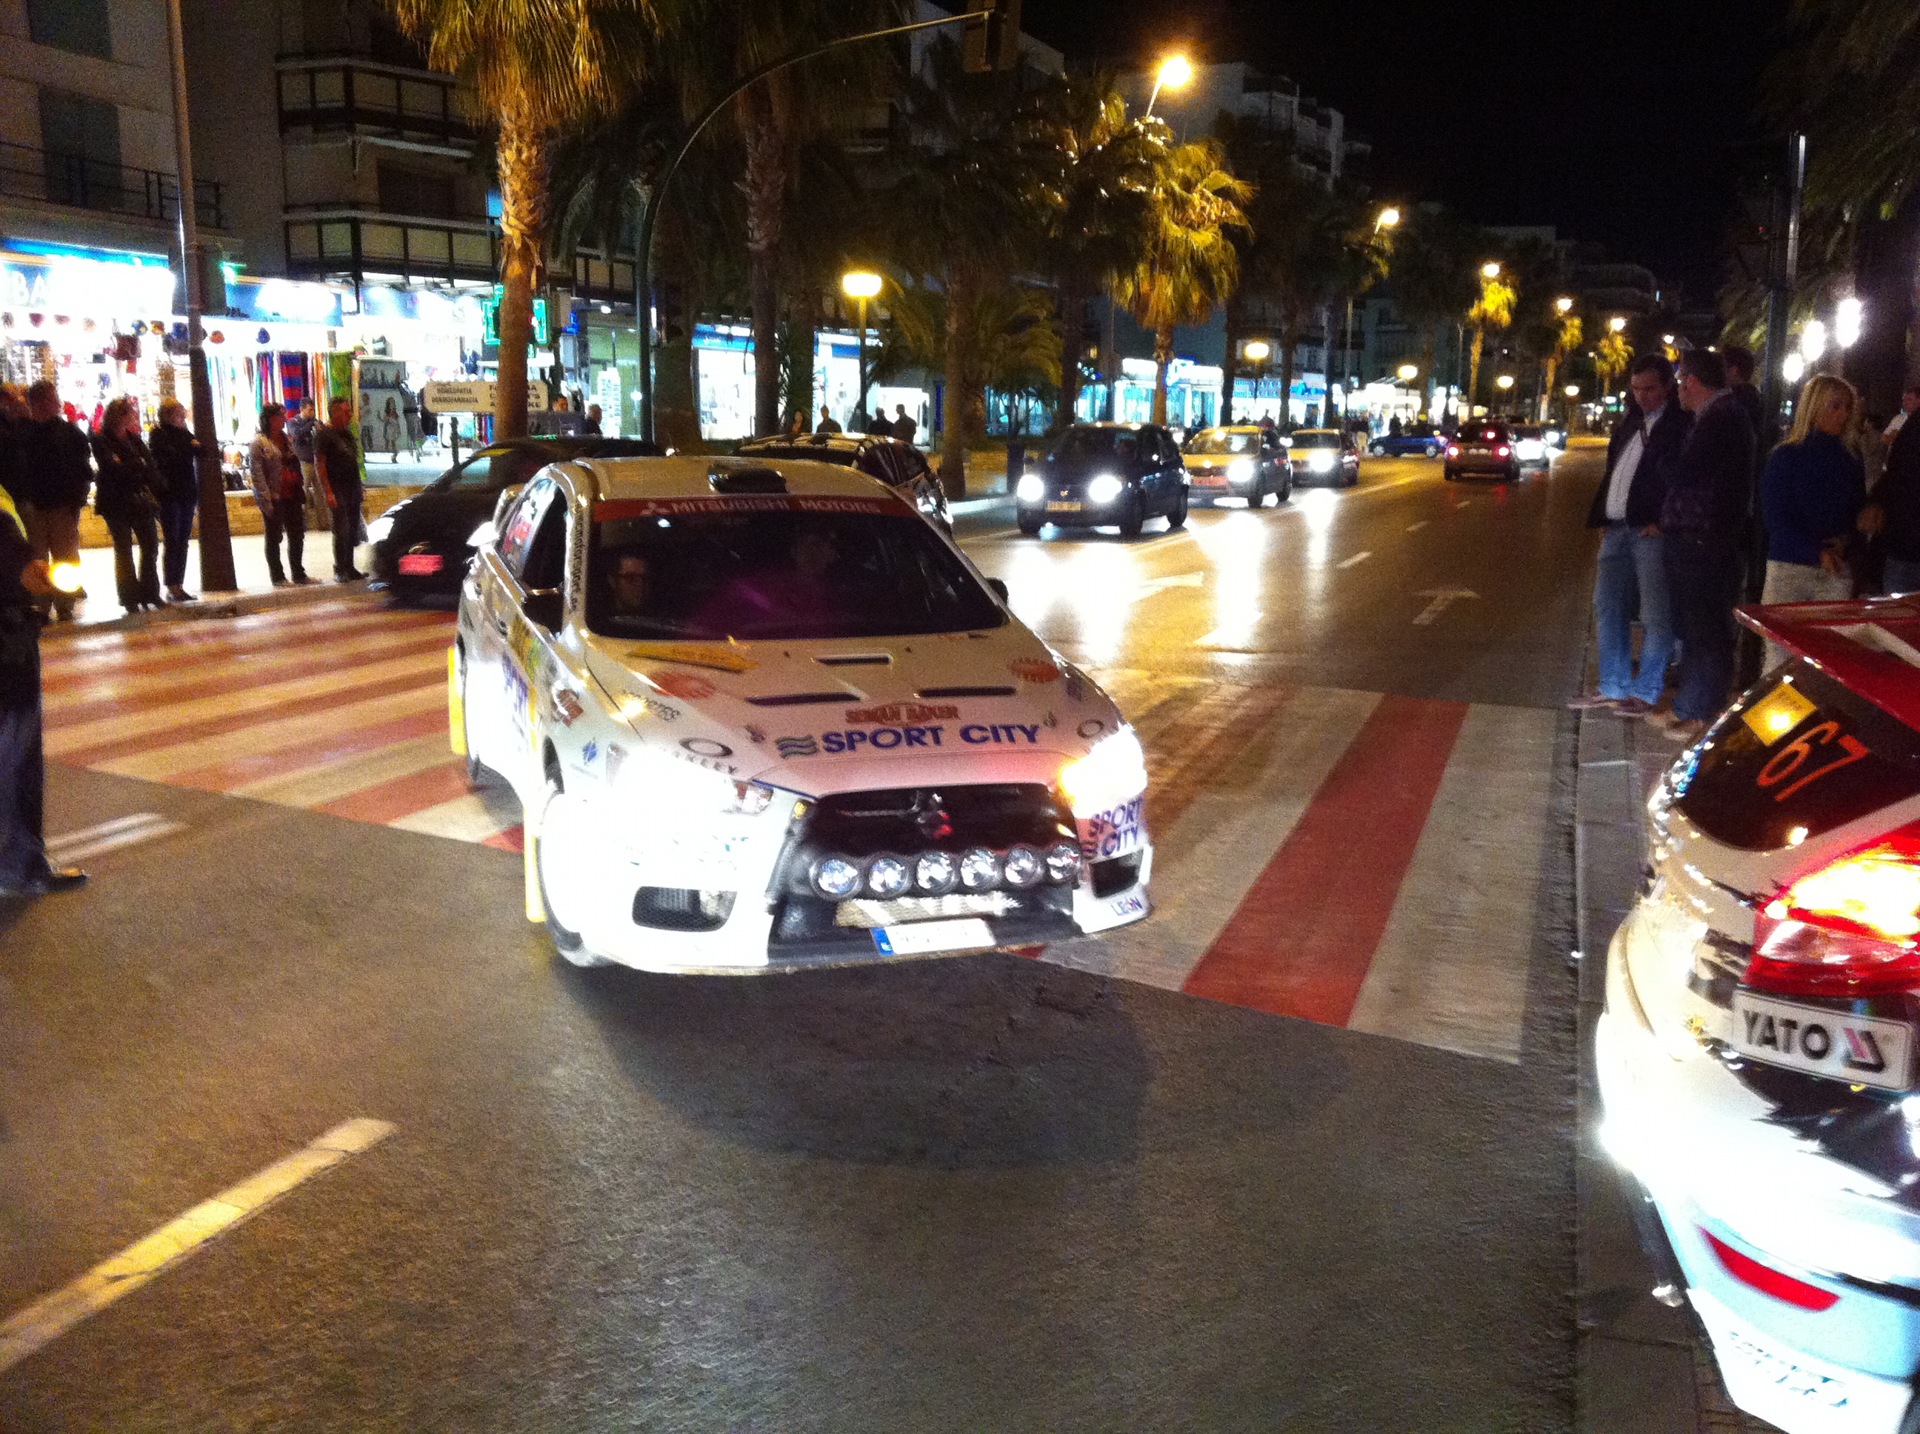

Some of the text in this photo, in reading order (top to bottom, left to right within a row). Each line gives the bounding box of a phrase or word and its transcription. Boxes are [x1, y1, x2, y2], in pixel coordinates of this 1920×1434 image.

[672, 500, 881, 514] MITSUBISHI MOTORS
[821, 723, 1040, 753] SPORT CITY
[1756, 720, 1871, 801] 67
[1088, 795, 1144, 837] SPORT
[1101, 825, 1139, 856] CITY
[1742, 1009, 1831, 1060] YATO
